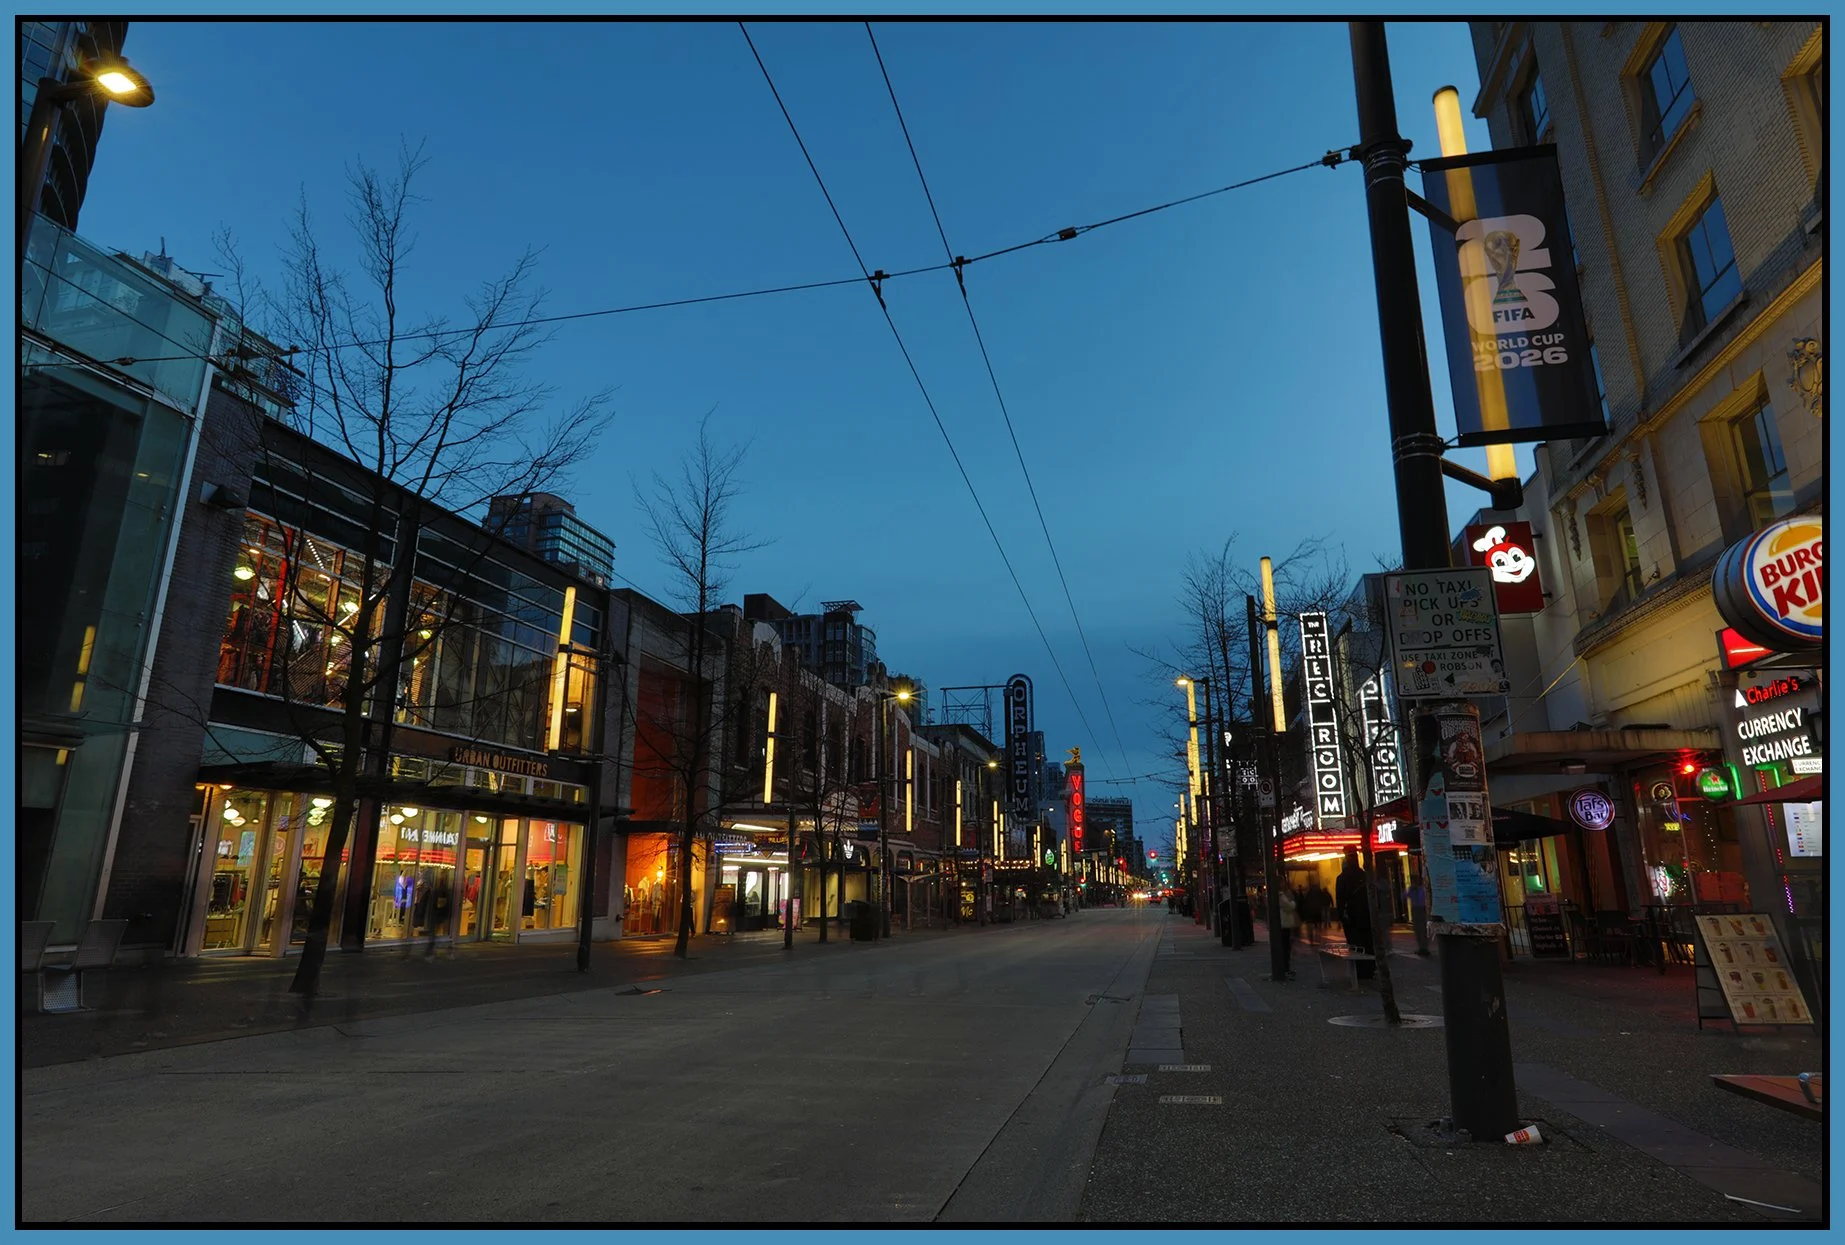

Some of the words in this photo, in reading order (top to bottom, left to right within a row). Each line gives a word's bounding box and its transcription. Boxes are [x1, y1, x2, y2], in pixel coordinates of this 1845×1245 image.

[1493, 307, 1535, 323] FIFA
[1471, 336, 1529, 353] WORLD
[1531, 332, 1565, 347] CUP
[1474, 346, 1569, 372] 2026
[1405, 582, 1429, 595] NO
[1436, 580, 1471, 594] TAXI
[1403, 597, 1440, 610] PICK
[1432, 613, 1455, 626] OR
[1452, 628, 1492, 642] OFFS
[1401, 653, 1419, 662] USE
[1424, 651, 1446, 660] TAXI
[1451, 650, 1478, 659] ZONE
[1440, 661, 1482, 671] ROBSON
[1747, 676, 1799, 705] Charlie's
[1737, 707, 1803, 741] CURRENCY
[1013, 685, 1029, 813] ORPHEUM
[1742, 735, 1813, 766] EXCHANGE
[455, 747, 490, 768] URBAN
[493, 755, 548, 777] OUTFITTERS
[1318, 728, 1340, 812] ROOM
[1071, 775, 1084, 855] VOGUE
[1584, 811, 1604, 822] Bar
